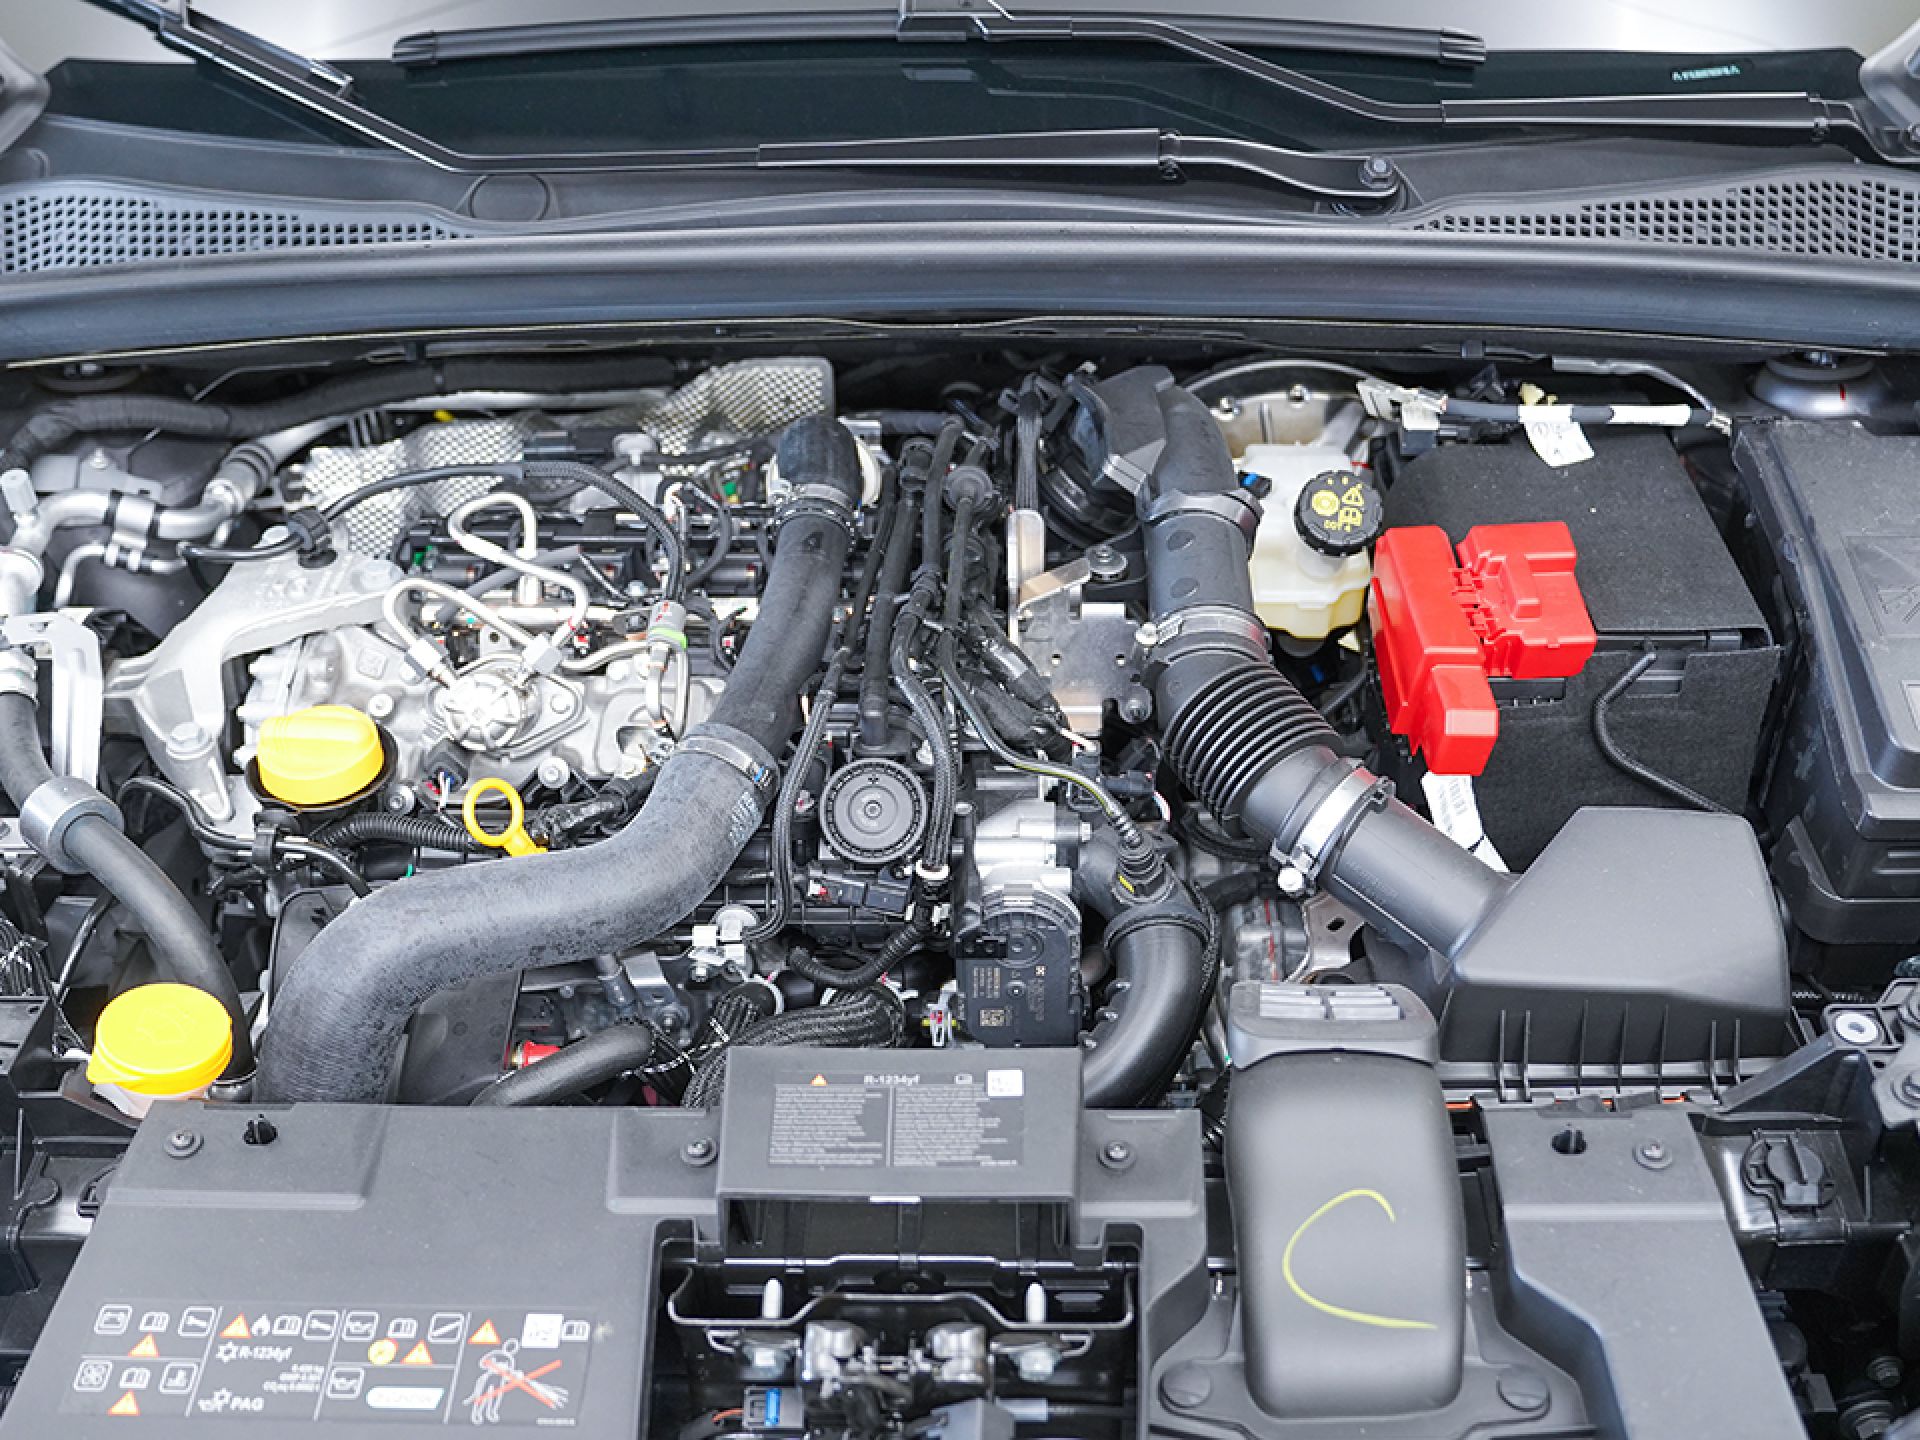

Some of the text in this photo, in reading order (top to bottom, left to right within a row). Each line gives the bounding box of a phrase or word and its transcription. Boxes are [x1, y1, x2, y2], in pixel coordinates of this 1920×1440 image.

[863, 1074, 920, 1087] R-1234yf
[239, 1346, 293, 1362] R-1234yf
[230, 1396, 265, 1411] PAG
